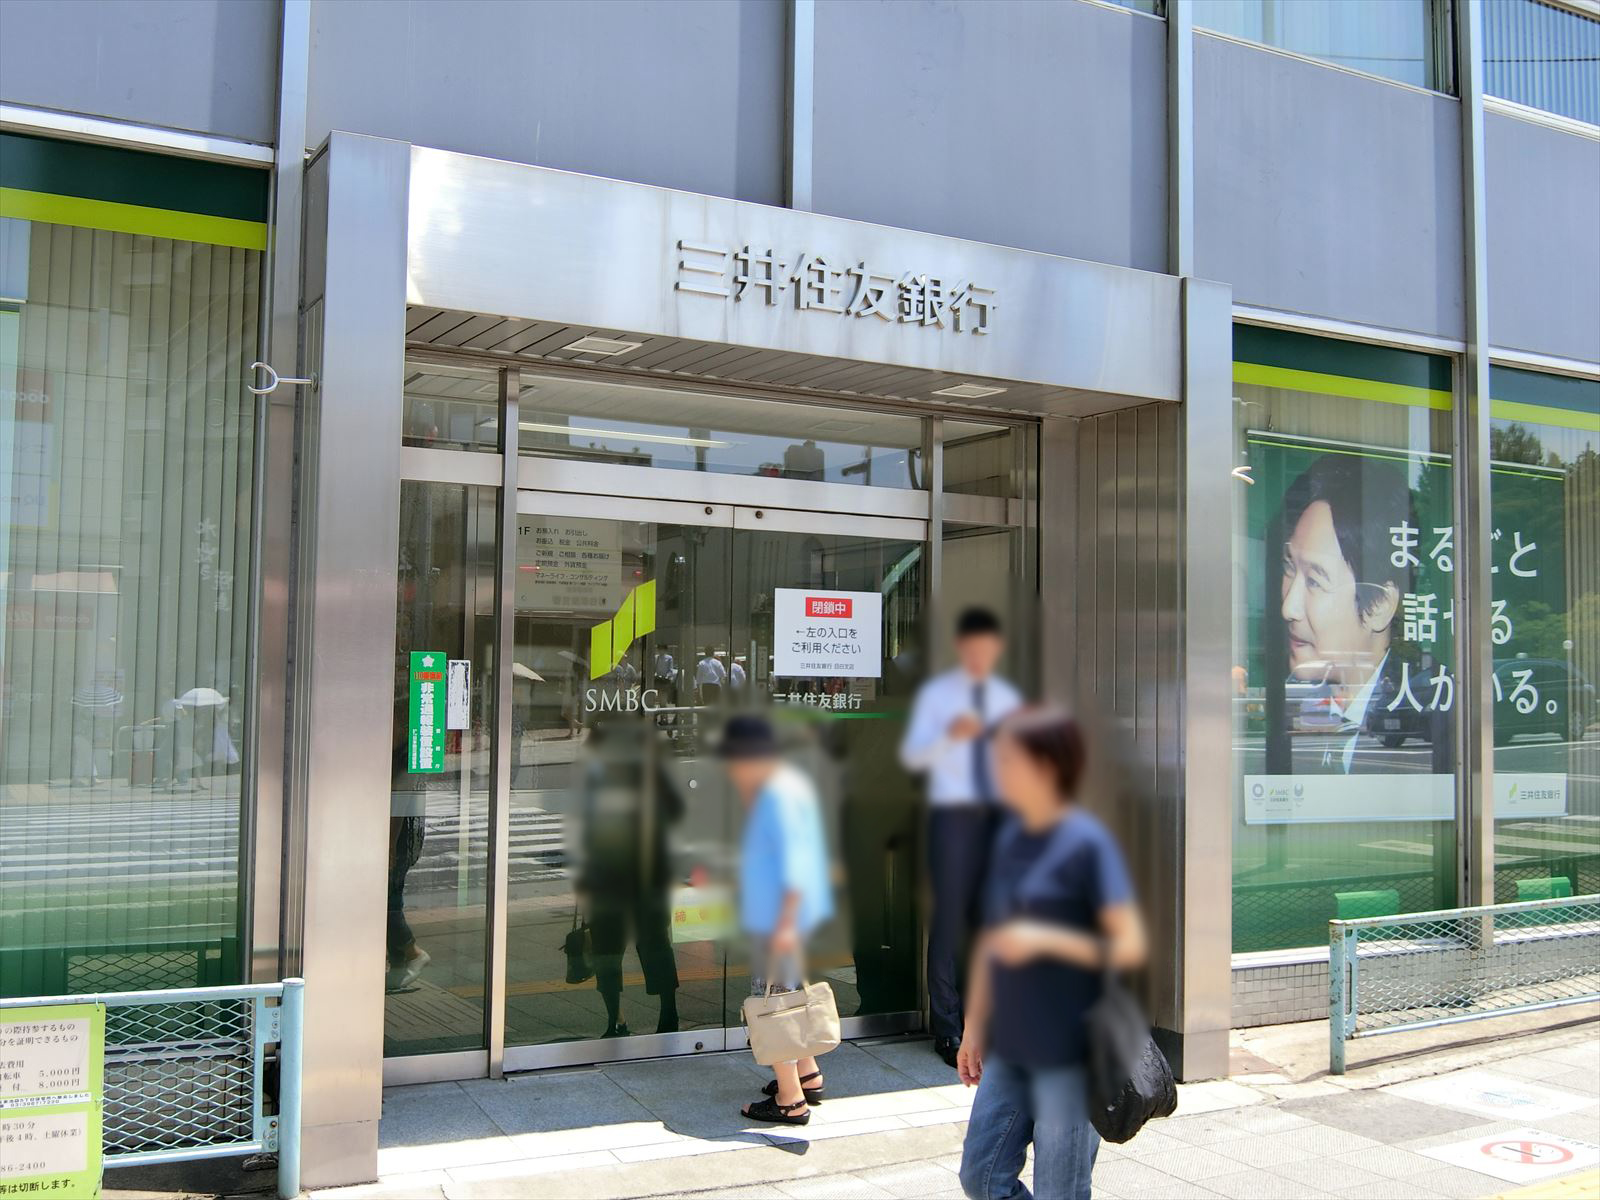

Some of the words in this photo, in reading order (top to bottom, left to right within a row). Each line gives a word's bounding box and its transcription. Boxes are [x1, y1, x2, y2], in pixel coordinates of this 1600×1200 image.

[675, 239, 998, 336] 三井住友銀行
[811, 600, 847, 615] 閉鎖中
[791, 642, 861, 655] ご利用ください
[585, 688, 659, 713] SMBC
